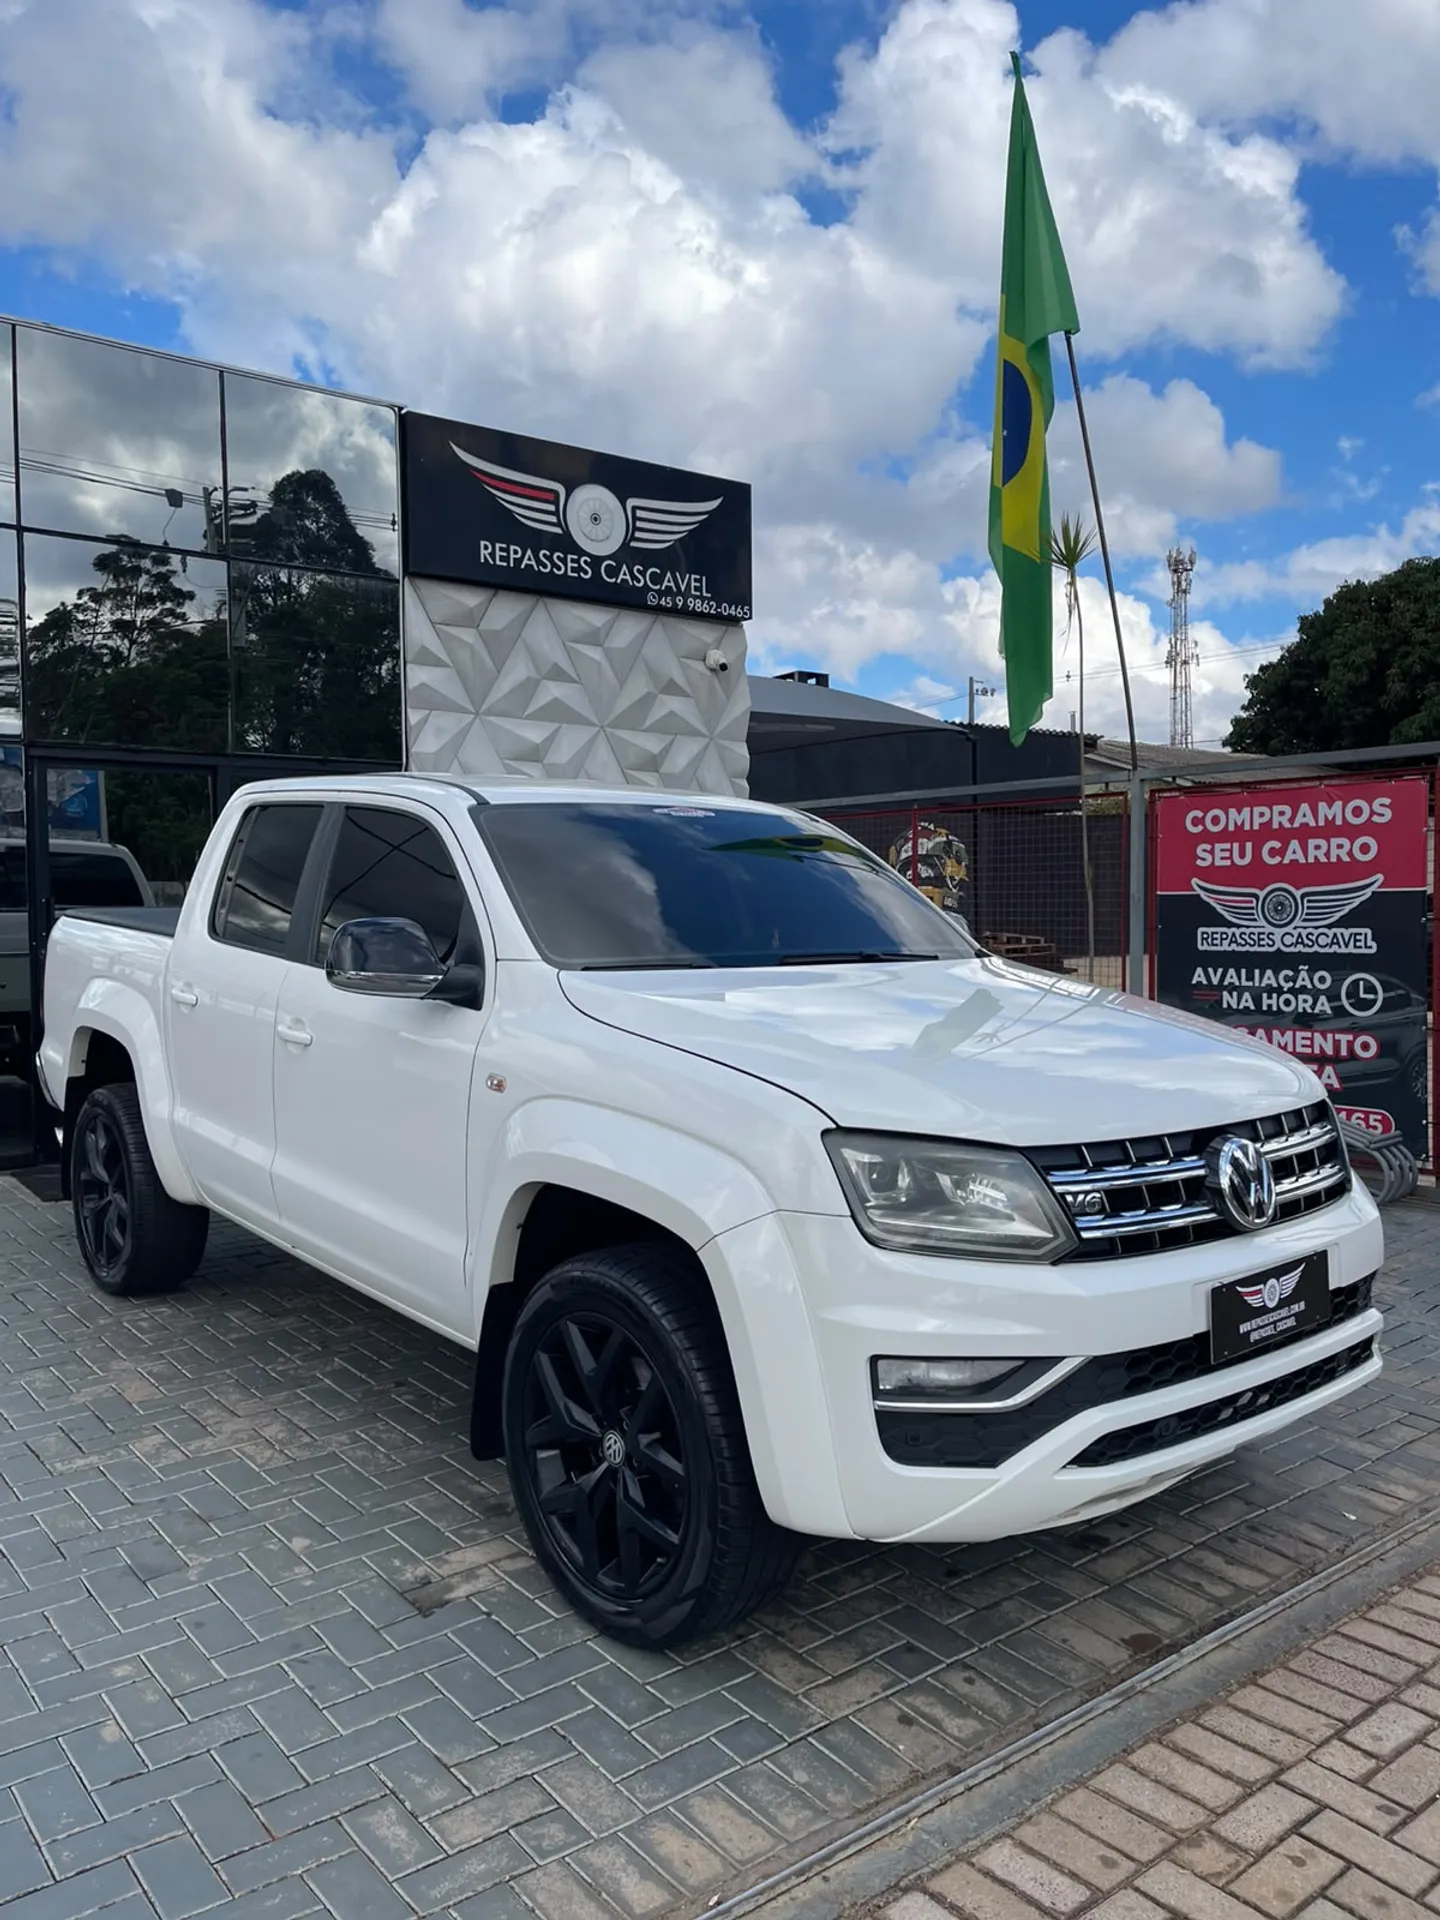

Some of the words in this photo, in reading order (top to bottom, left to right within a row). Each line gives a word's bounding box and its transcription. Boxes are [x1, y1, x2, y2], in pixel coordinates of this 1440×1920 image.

[480, 541, 593, 579] REPASSES
[601, 559, 712, 597] CASCAVEL
[660, 596, 673, 608] 45
[676, 596, 684, 609] 9
[687, 598, 750, 618] 9862-0465
[1185, 797, 1393, 833] COMPRAMOS
[1196, 841, 1253, 867] SEU
[1261, 836, 1378, 864] CARRO
[1200, 931, 1276, 948] REPASSES
[1280, 931, 1373, 949] CASCAVEL
[1191, 965, 1332, 991] AVALIAÇÃO
[1222, 991, 1255, 1010] NA
[1262, 993, 1332, 1014] HORA
[1235, 1027, 1378, 1059] AMENTO
[1065, 1191, 1103, 1214] V6
